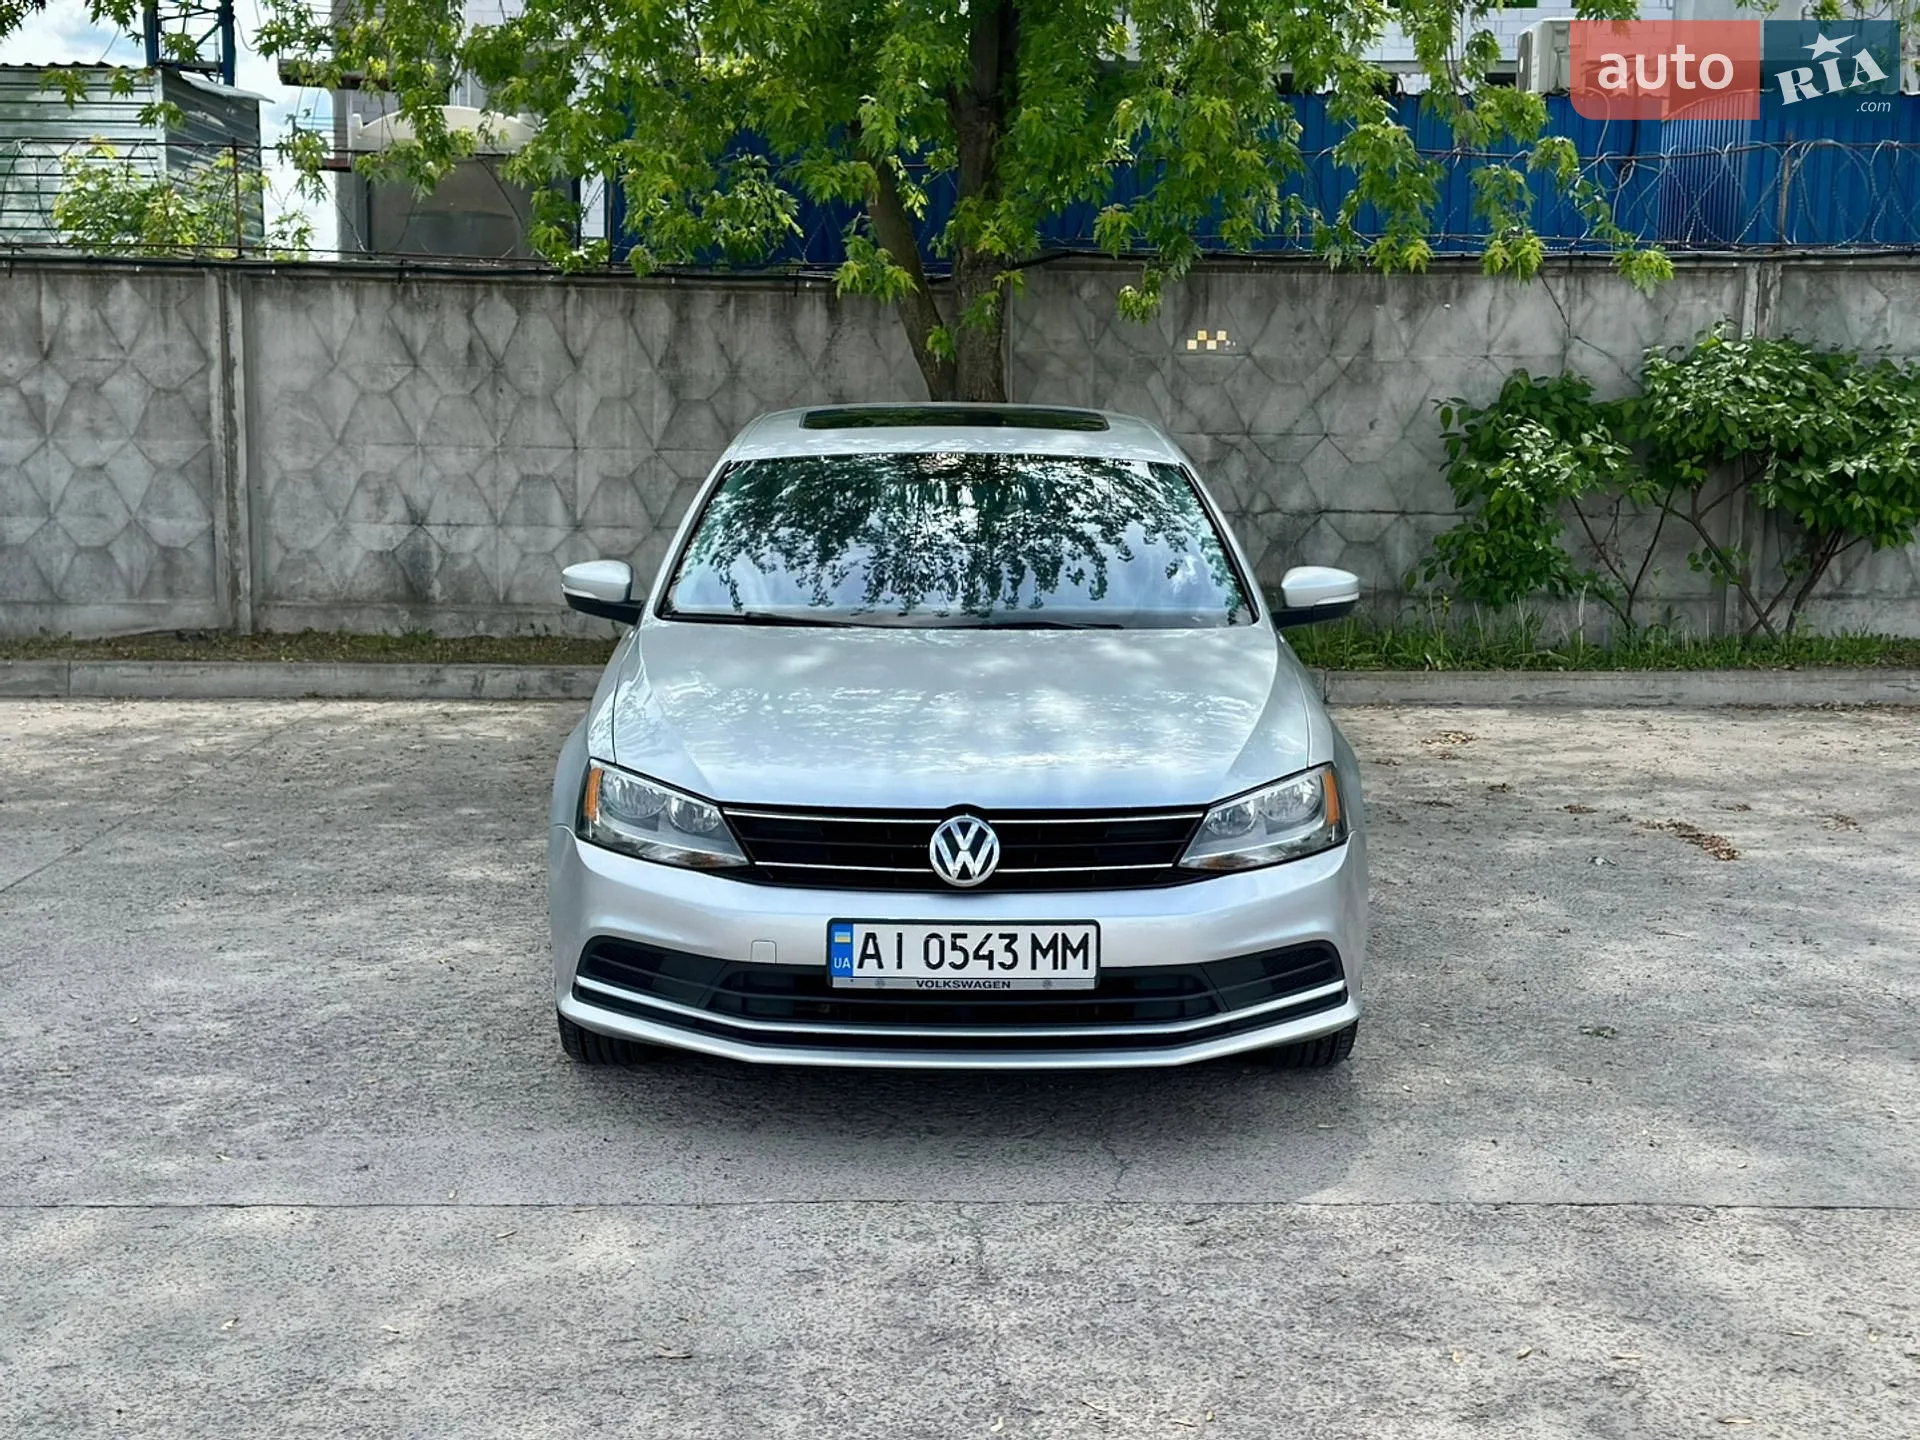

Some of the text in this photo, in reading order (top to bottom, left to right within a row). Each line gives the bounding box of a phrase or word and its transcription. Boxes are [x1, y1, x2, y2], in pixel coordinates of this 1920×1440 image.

[932, 817, 998, 884] VW
[857, 932, 1089, 970] AI 0543 MM
[833, 958, 851, 969] UA
[916, 980, 1011, 989] VOLKSWAGEN
